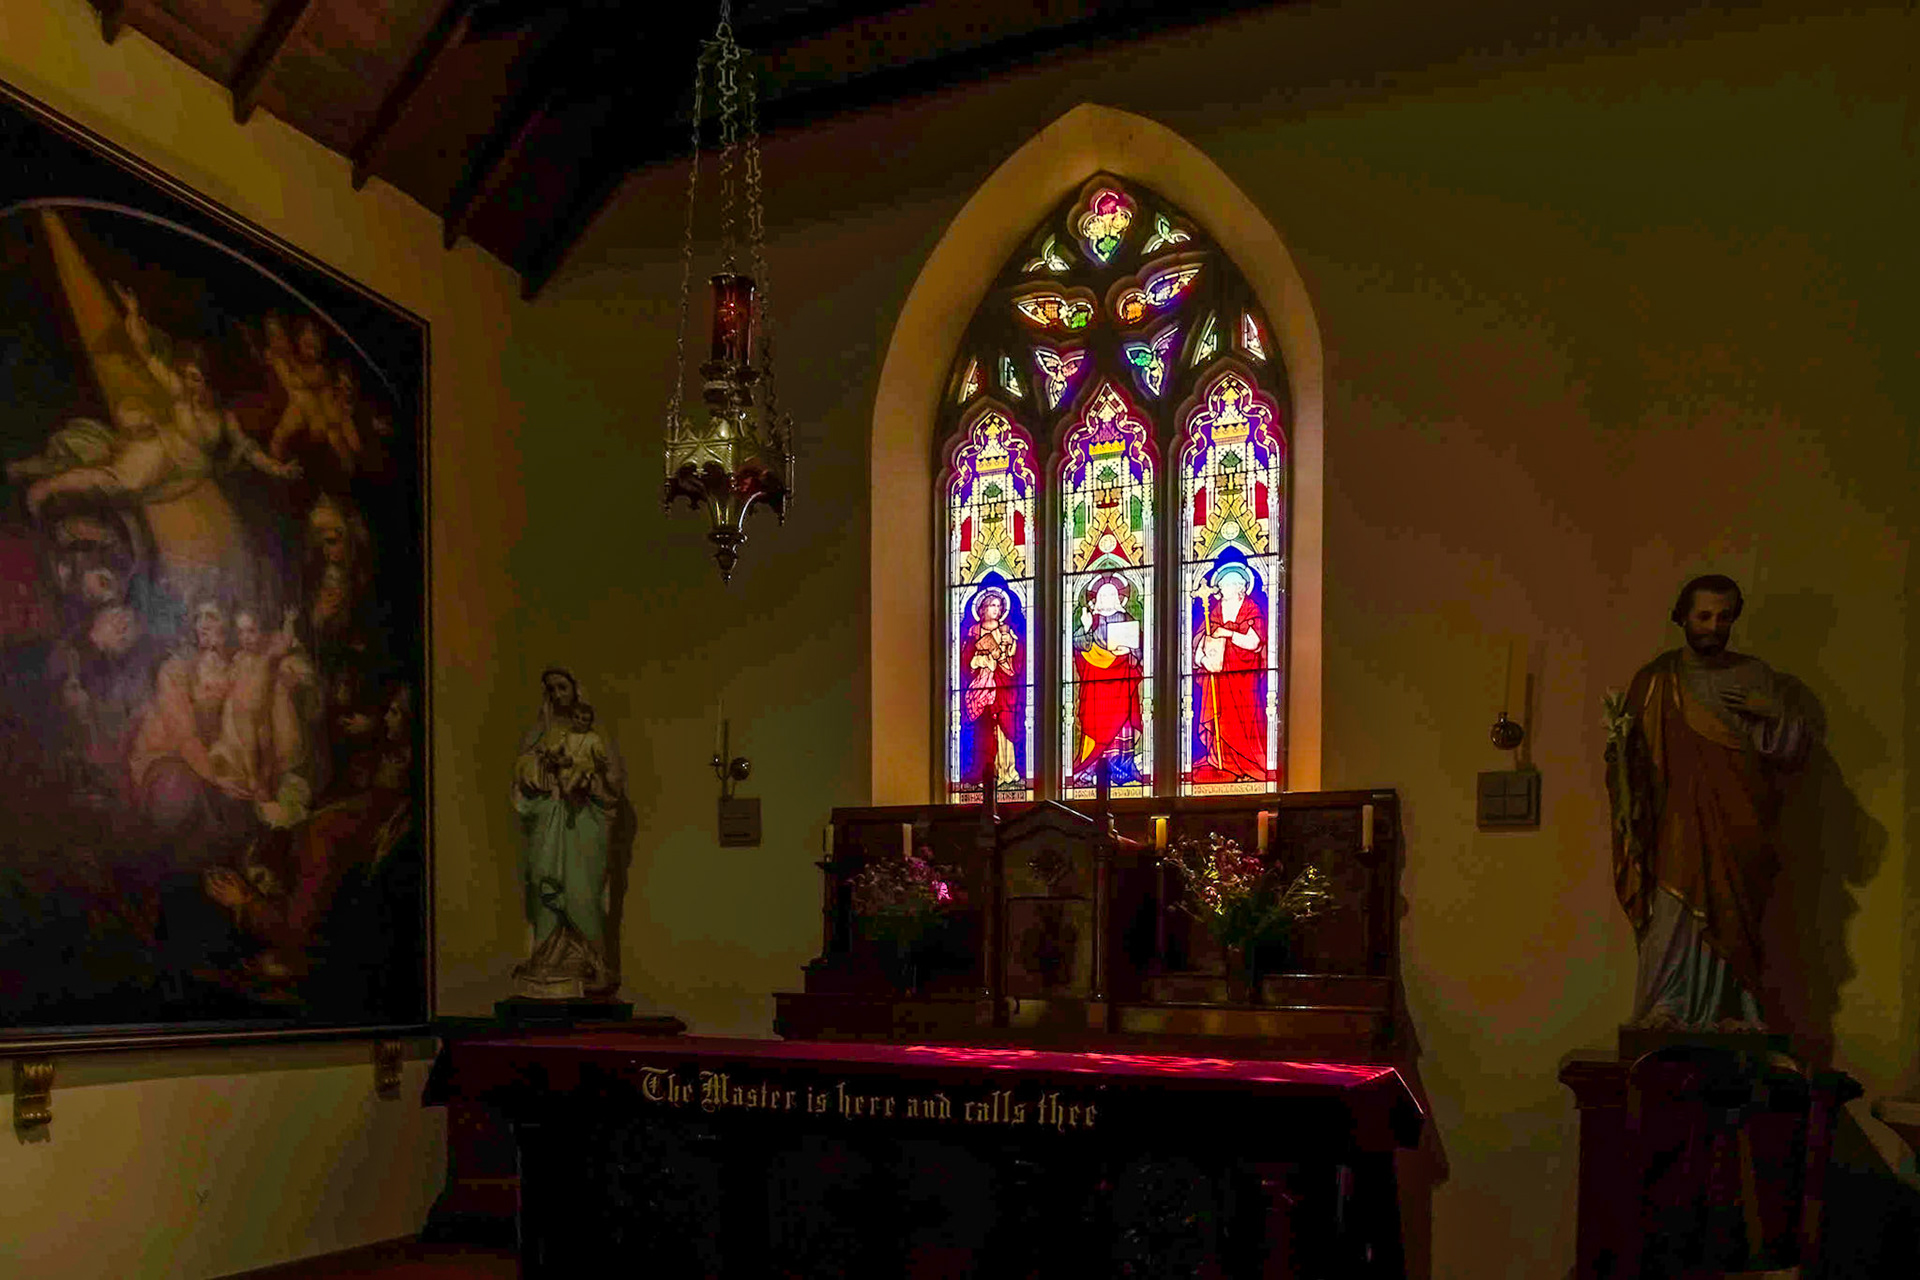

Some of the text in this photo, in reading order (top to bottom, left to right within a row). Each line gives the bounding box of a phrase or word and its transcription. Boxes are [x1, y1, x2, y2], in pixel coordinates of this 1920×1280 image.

[640, 1066, 1098, 1134] The Master is here and calls thee
